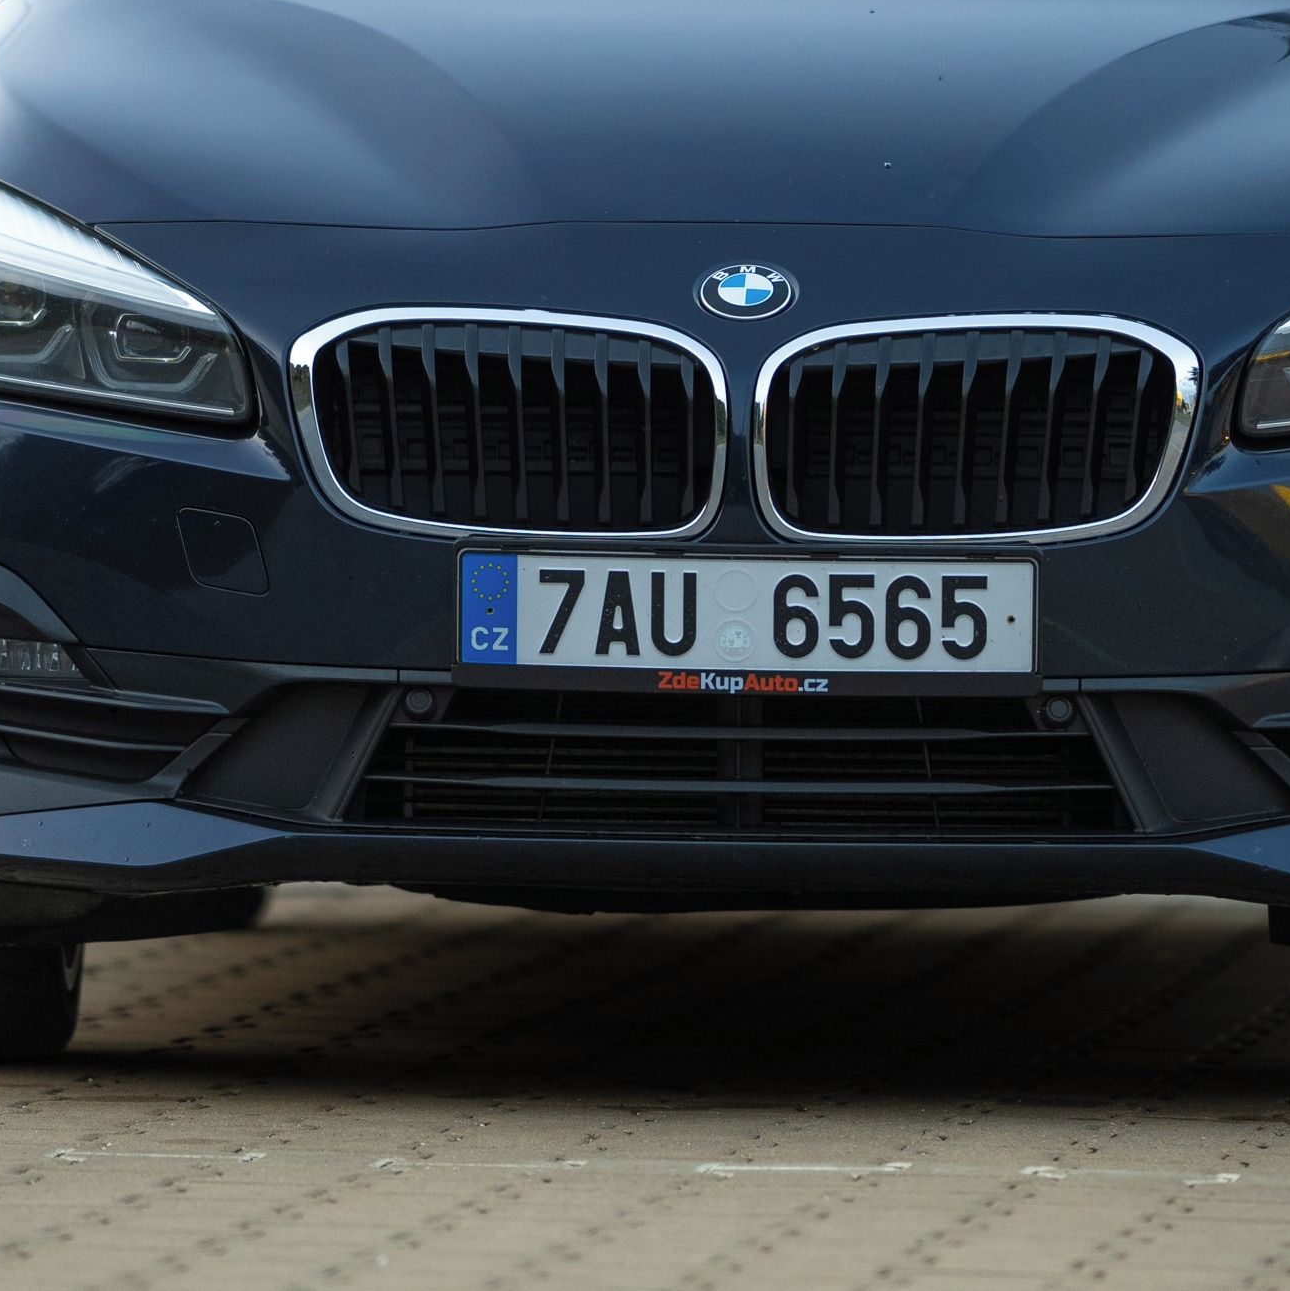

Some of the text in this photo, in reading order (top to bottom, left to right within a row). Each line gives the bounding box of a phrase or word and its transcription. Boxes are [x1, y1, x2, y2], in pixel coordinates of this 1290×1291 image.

[712, 265, 784, 283] BMW
[538, 569, 989, 661] 7AU 6565
[470, 626, 509, 651] CZ
[657, 671, 829, 694] ZdeKupAuto.cz
